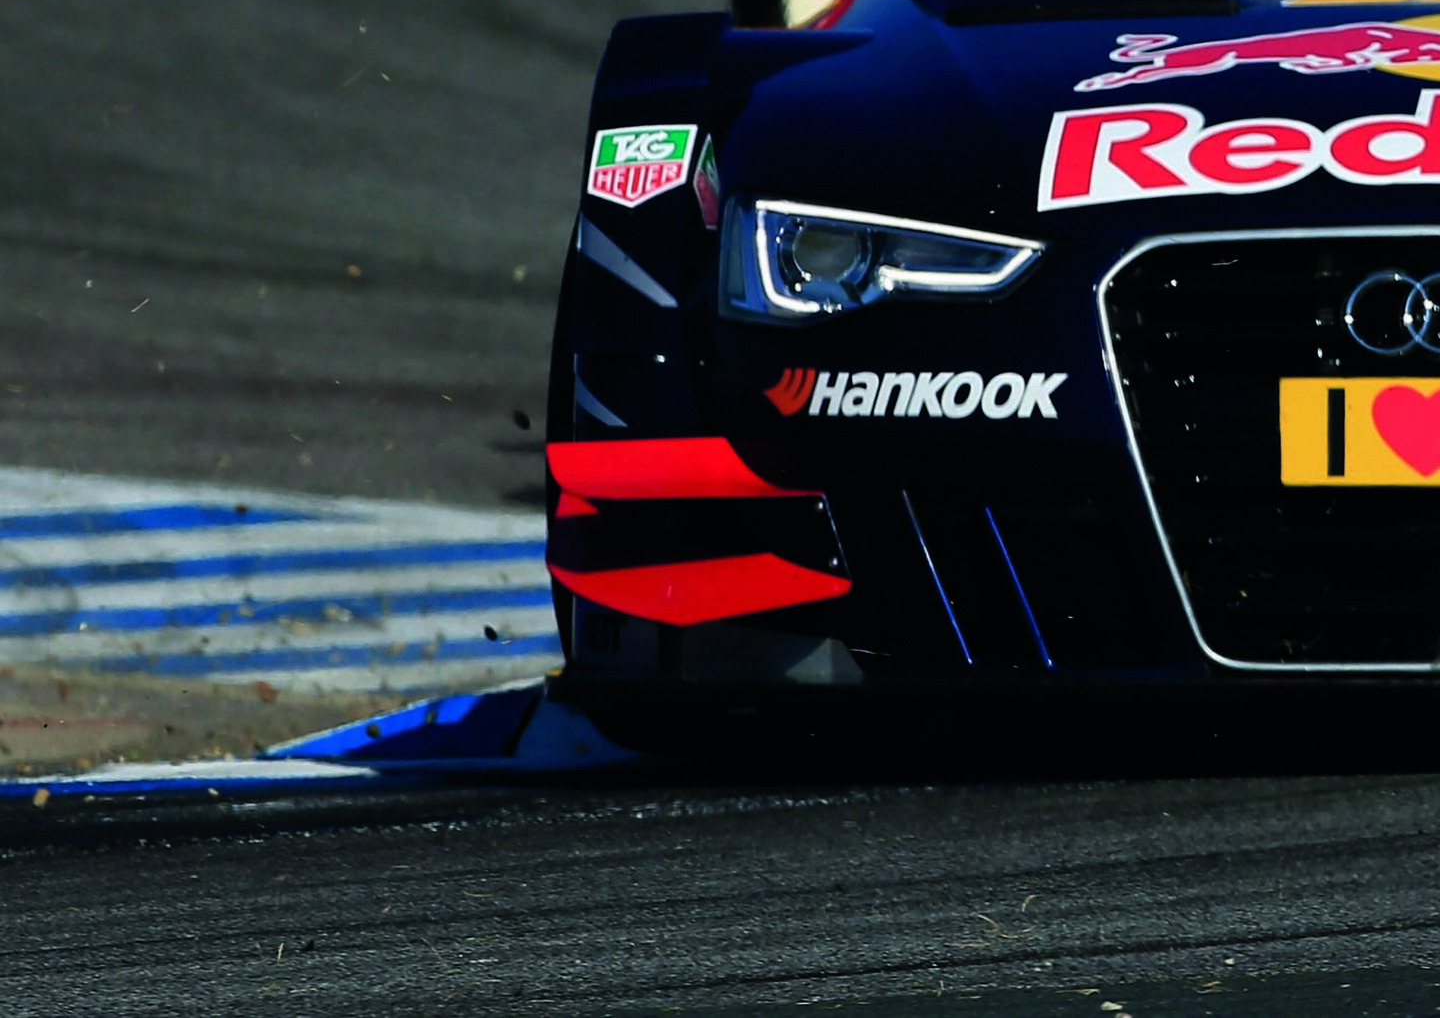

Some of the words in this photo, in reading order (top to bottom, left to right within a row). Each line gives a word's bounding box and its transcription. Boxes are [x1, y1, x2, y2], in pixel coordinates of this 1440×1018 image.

[612, 130, 676, 163] TAG
[595, 164, 679, 200] HEUER
[1327, 387, 1346, 477] I
